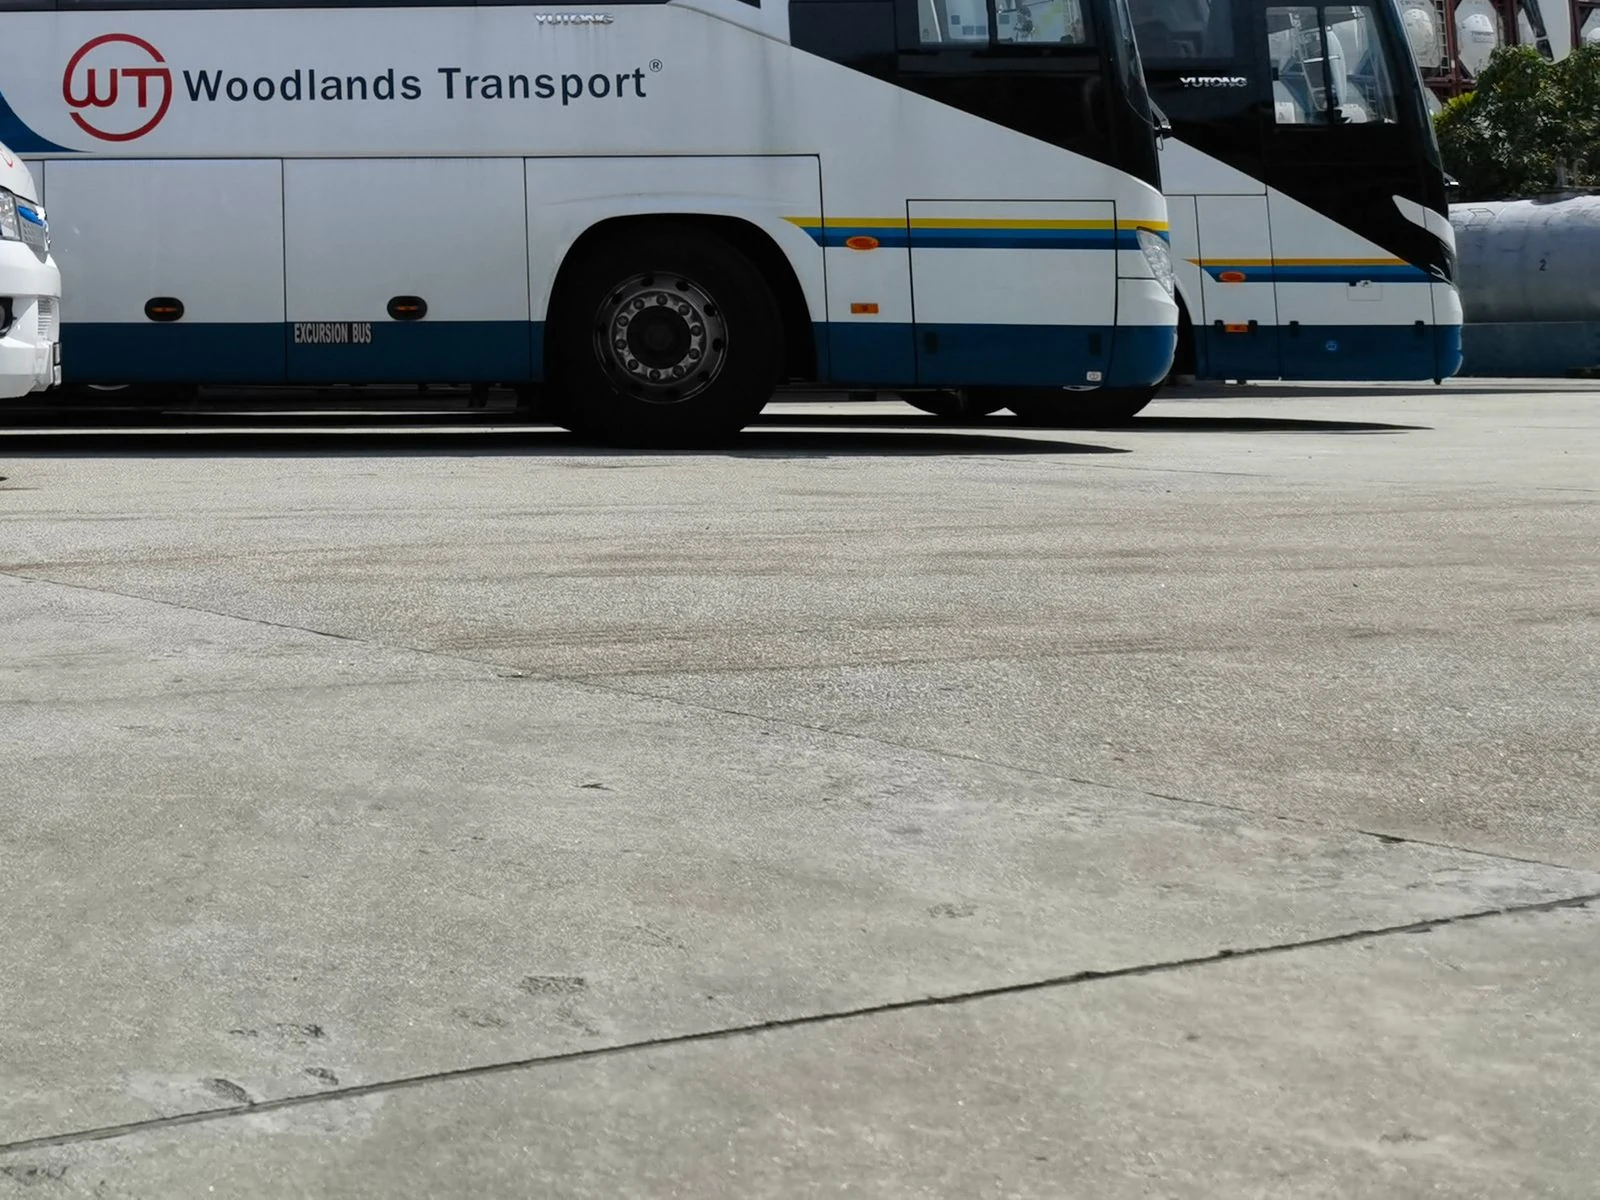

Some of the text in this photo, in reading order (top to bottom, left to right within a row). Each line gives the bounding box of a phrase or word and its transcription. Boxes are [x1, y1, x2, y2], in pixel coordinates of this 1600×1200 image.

[535, 13, 614, 25] YUTONG
[183, 68, 422, 102] Woodlands
[1180, 77, 1247, 88] YUTONG
[294, 323, 372, 344] EXCURSION BUS
